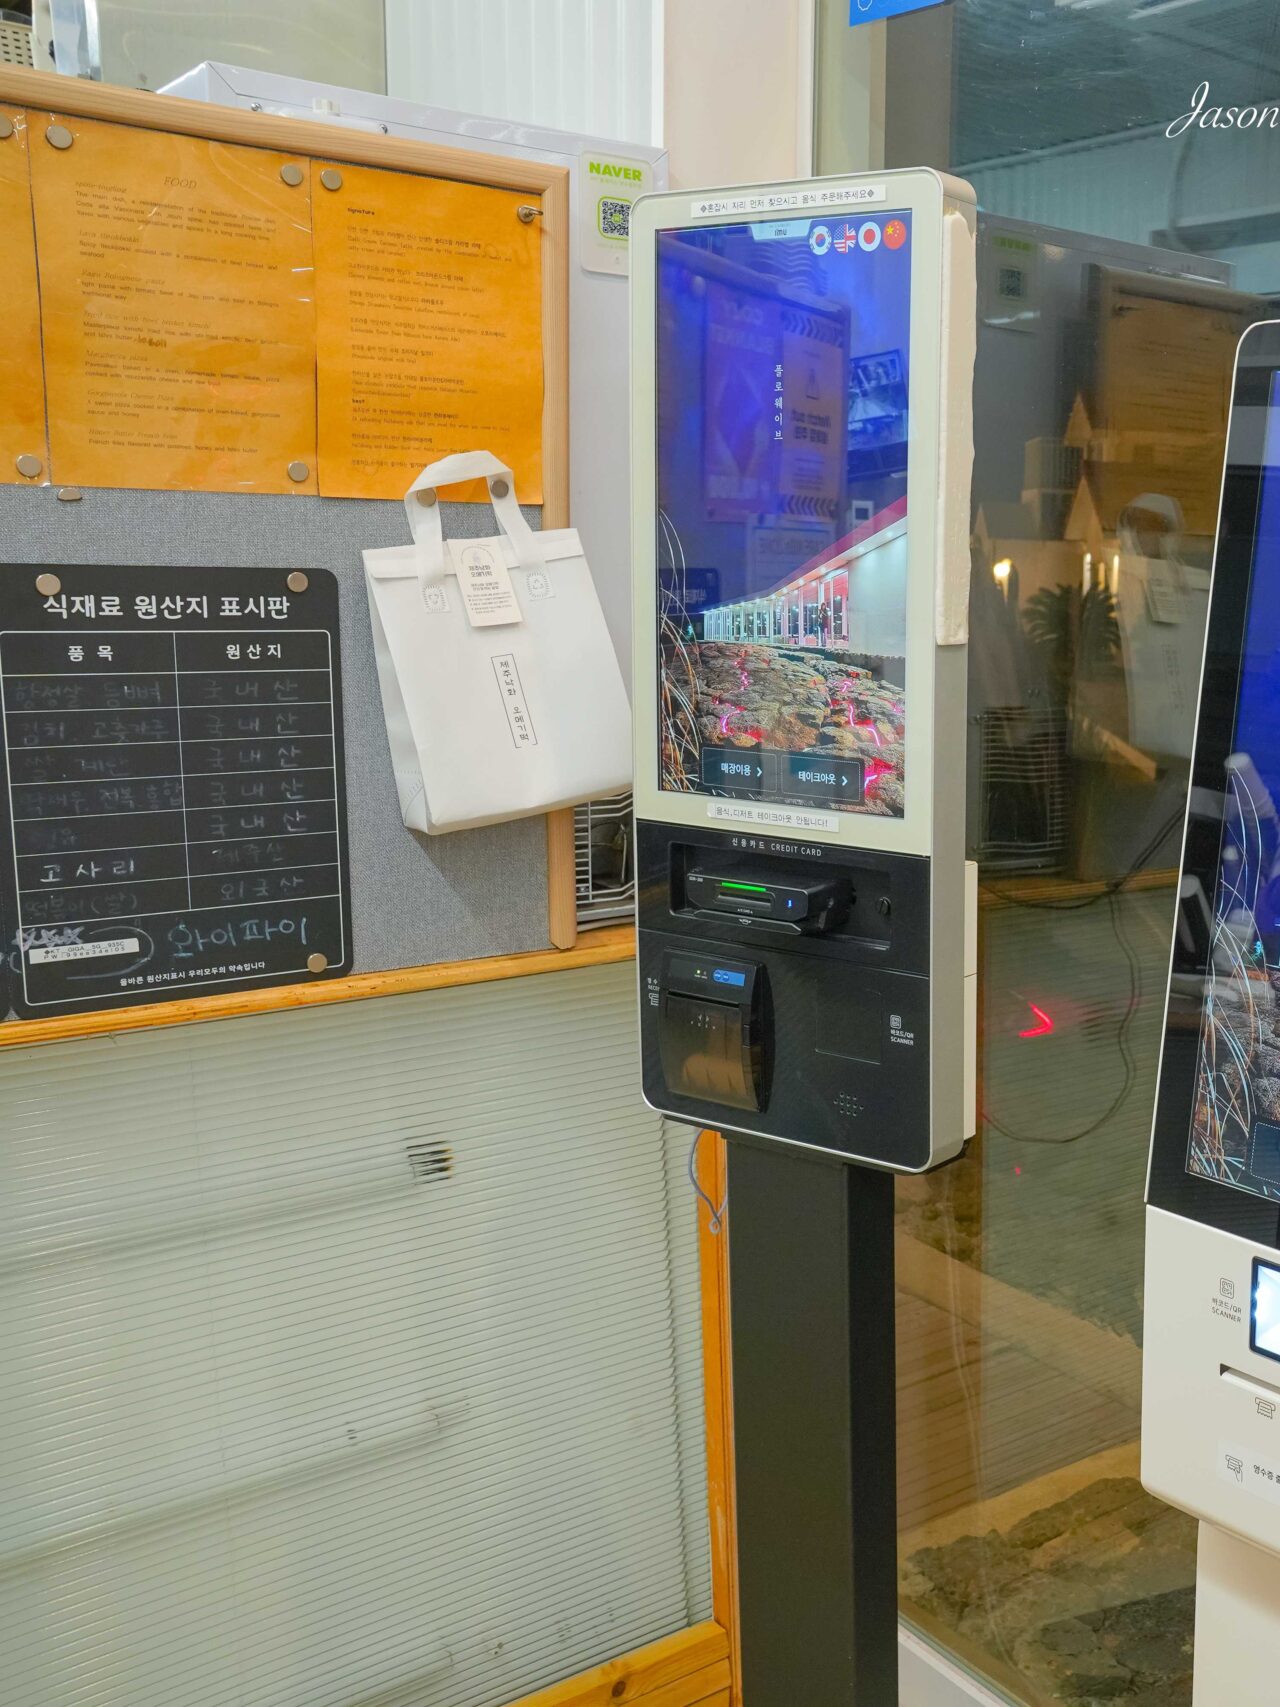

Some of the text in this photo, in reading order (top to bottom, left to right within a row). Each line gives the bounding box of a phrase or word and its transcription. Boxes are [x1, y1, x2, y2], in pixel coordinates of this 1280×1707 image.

[588, 160, 643, 182] NAVER
[164, 176, 197, 189] FOOD
[774, 364, 784, 441] 플로웨이브
[43, 594, 290, 620] 식재료 원산지 표시판
[721, 762, 751, 776] 매장이용
[798, 771, 837, 785] 테이크아웃
[771, 843, 798, 854] CREDIT
[801, 847, 822, 857] CARD
[40, 858, 136, 884] 고사리
[1211, 1306, 1242, 1323] SCANNER
